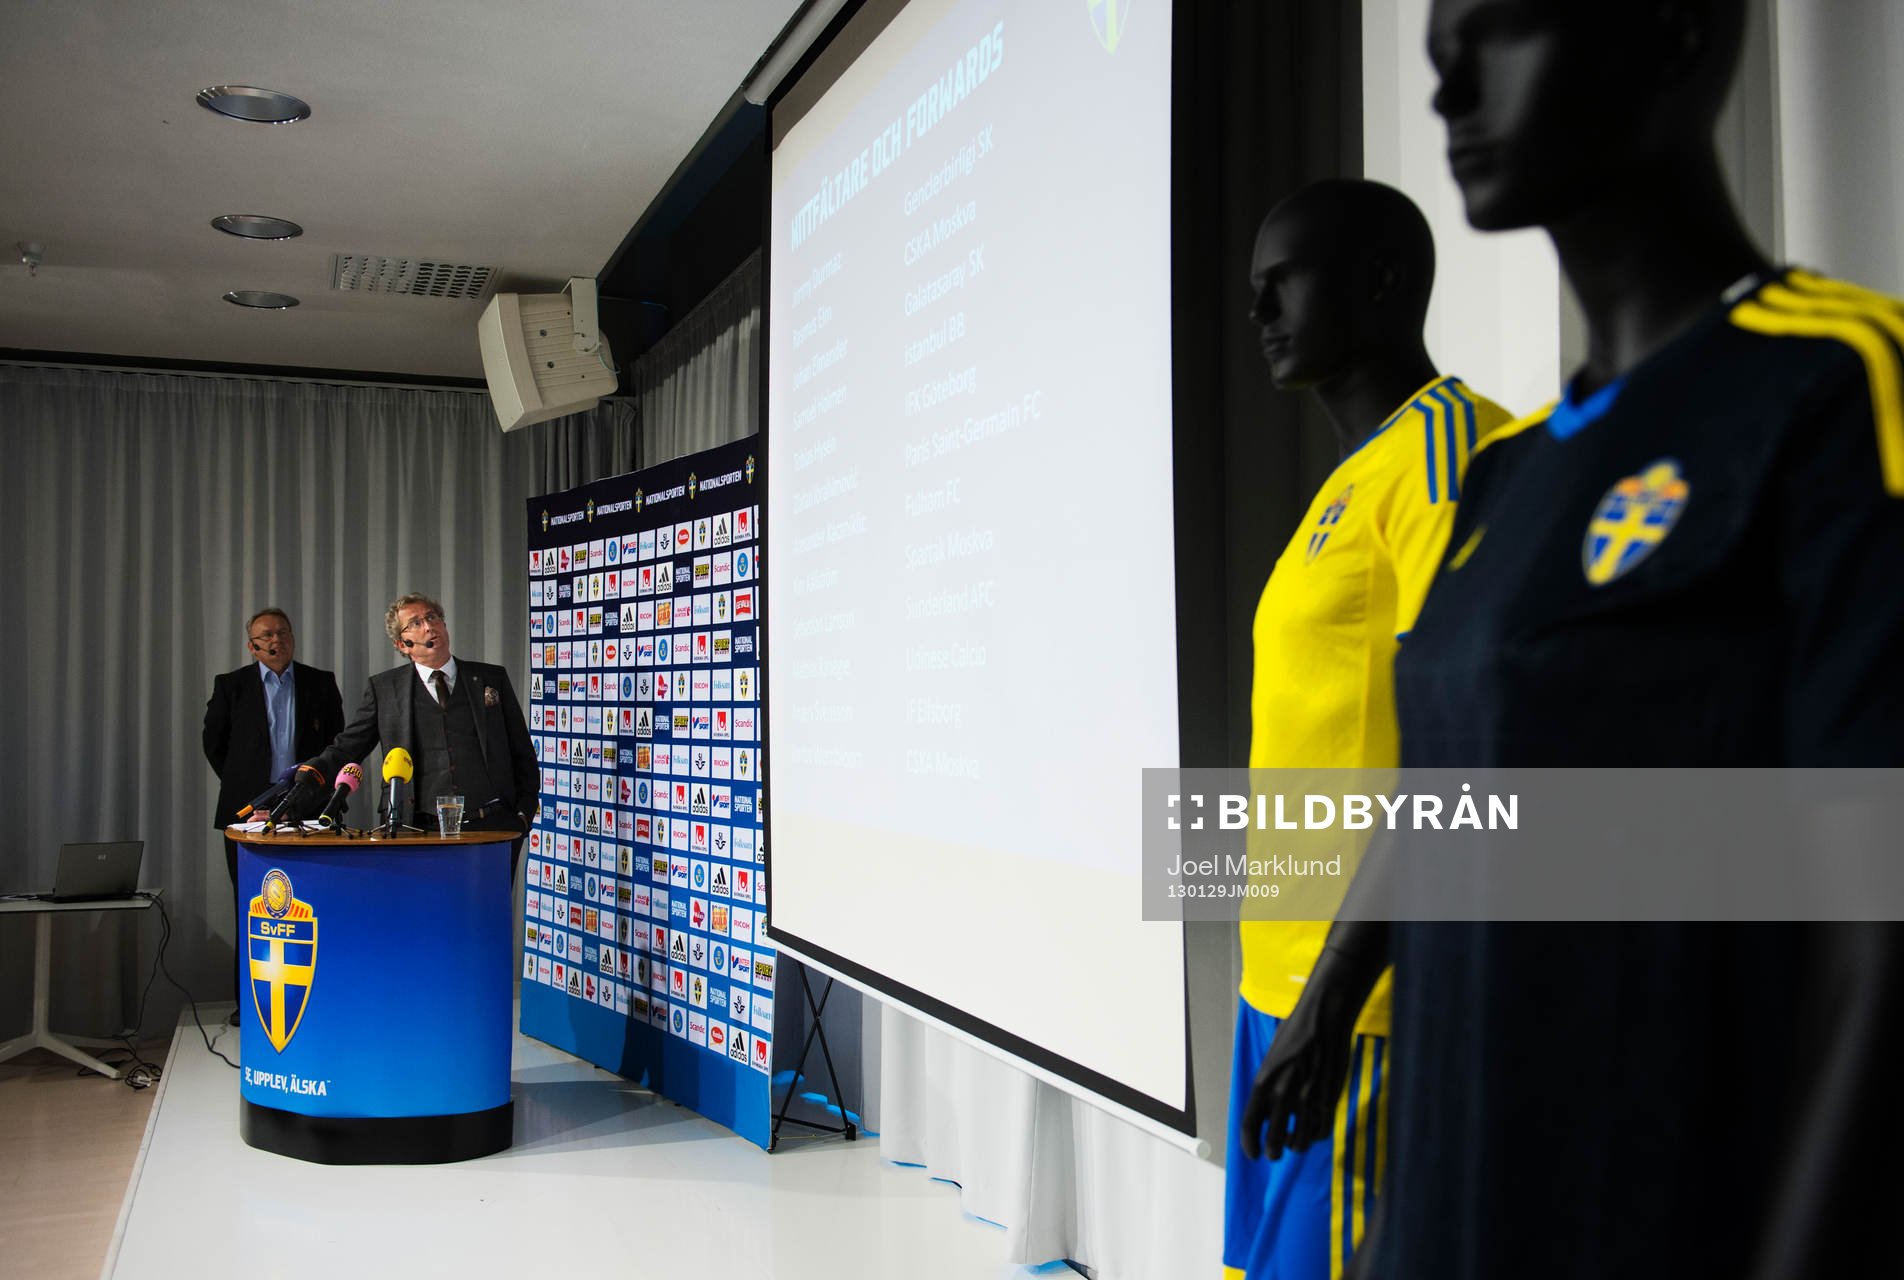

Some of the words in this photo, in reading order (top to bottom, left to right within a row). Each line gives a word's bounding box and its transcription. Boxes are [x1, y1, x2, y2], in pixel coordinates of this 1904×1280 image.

[791, 148, 869, 254] MITTFÄLTARE
[873, 116, 902, 177] OCH
[906, 20, 1004, 149] FORWARDS
[978, 123, 993, 158] SK
[904, 228, 931, 267] CSKA
[933, 200, 977, 247] Moskva
[904, 261, 966, 317] Galatasaray
[969, 241, 985, 278] SK
[950, 312, 965, 344] BB
[923, 366, 977, 408] Göteborg
[905, 440, 930, 471] Paris
[932, 402, 1020, 459] Saint-Germain
[1023, 390, 1041, 423] FC
[646, 485, 686, 505] NATIONALSPORTEN
[700, 470, 742, 491] NATIONALSPORTEN
[946, 477, 961, 504] FC
[597, 500, 632, 516] NATIONALSPORTEN
[947, 527, 993, 561] Moskva
[969, 579, 996, 608] AFC
[735, 719, 752, 728] Scandic
[261, 921, 295, 937] SvFF
[734, 919, 750, 929] RICOH
[253, 1070, 288, 1094] UPPLEV,
[290, 1074, 327, 1096] ÄLSKA
